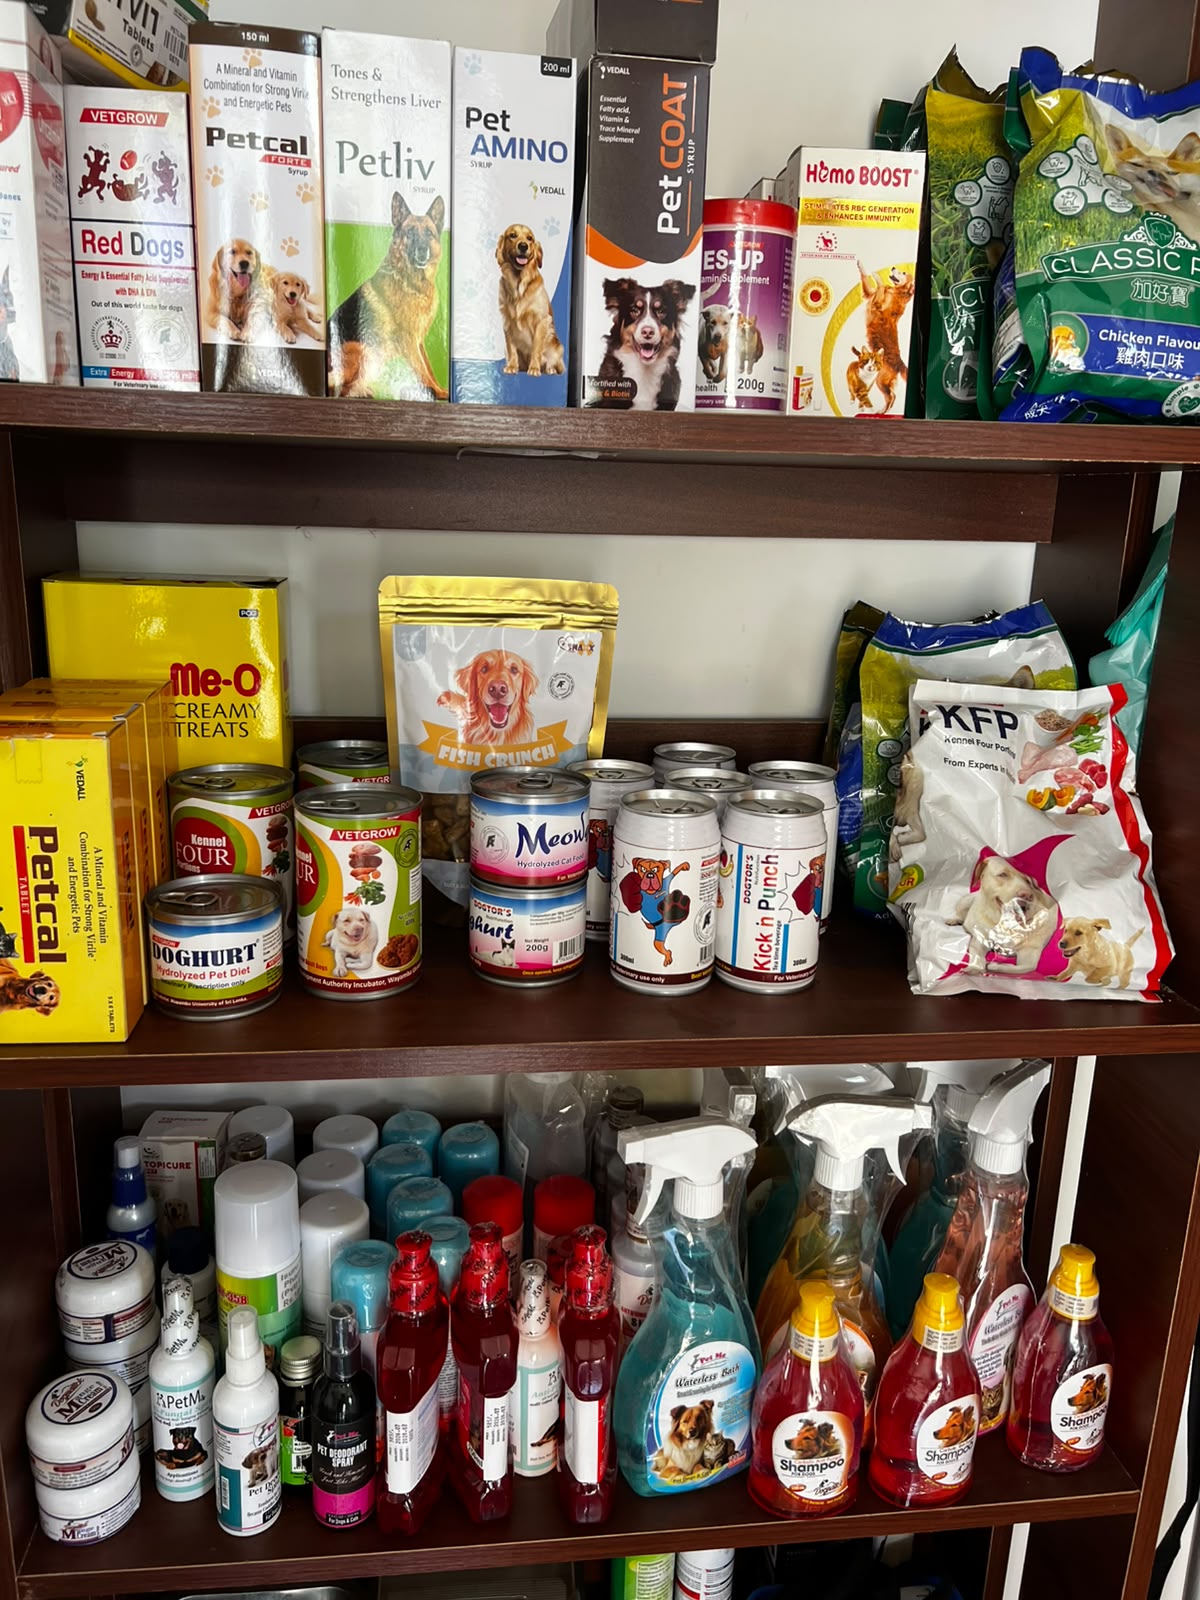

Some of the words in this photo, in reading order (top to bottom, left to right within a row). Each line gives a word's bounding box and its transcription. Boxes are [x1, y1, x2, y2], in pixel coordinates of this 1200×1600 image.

[122, 18, 154, 53] Tablets
[241, 31, 257, 42] 150
[259, 33, 271, 43] ml
[216, 63, 222, 74] A
[224, 64, 251, 77] Mineral
[253, 67, 267, 79] and
[269, 69, 298, 82] Vitamin
[331, 64, 368, 81] Tones
[372, 67, 383, 82] &
[543, 62, 558, 74] 200
[559, 64, 570, 75] ml
[606, 66, 631, 76] VEDALL
[203, 78, 250, 94] Combination
[252, 82, 263, 94] for
[265, 84, 290, 100] Strong
[331, 86, 407, 108] Strengthens
[411, 94, 442, 109] Liver
[224, 96, 237, 108] and
[239, 97, 273, 112] Energetic
[275, 100, 292, 114] Pets
[599, 95, 627, 104] Essential
[91, 110, 157, 126] VETGROW
[599, 105, 616, 114] Fatty
[464, 106, 511, 132] Pet
[599, 115, 623, 124] Vitamin
[624, 116, 630, 124] &
[660, 73, 687, 170] COAT
[599, 125, 616, 133] Trace
[617, 126, 641, 135] Mineral
[206, 126, 308, 156] Petcal
[598, 135, 634, 145] Supplement
[470, 134, 568, 164] AMINO
[687, 139, 695, 174] SYRUP
[271, 155, 308, 166] FORTE
[334, 140, 435, 181] Petliv
[470, 159, 493, 169] SYRUP
[287, 166, 309, 178] Syrup
[859, 165, 913, 188] BOOST
[413, 185, 436, 195] SYRUP
[540, 186, 566, 196] VEDALL
[657, 175, 682, 234] Pet
[851, 204, 867, 213] RBC
[868, 206, 914, 215] GENERATION
[824, 211, 864, 221] ENHANCES
[865, 214, 901, 223] IMMUNITY
[82, 229, 123, 256] Red
[131, 231, 185, 265] Dogs
[1051, 248, 1181, 275] CLASSIC
[1132, 279, 1187, 307] 加好寶
[91, 300, 102, 308] Out
[103, 301, 110, 309] of
[112, 301, 123, 309] this
[1099, 328, 1153, 346] Chicken
[1116, 345, 1185, 371] 雞肉口味
[90, 367, 108, 377] Extra
[111, 369, 135, 381] Energy
[617, 380, 631, 388] with
[737, 377, 765, 394] 200g
[170, 662, 262, 698] Me-O
[174, 702, 261, 719] CREAMY
[174, 721, 249, 739] TREATS
[936, 703, 1019, 741] KFP
[976, 739, 993, 751] Four
[438, 743, 481, 768] FISH
[483, 743, 556, 769] CRUNCH
[943, 757, 966, 769] From
[968, 759, 999, 773] Experts
[76, 769, 86, 800] VEDALL
[191, 833, 227, 848] Kennel
[337, 826, 398, 841] VETGROW
[93, 846, 103, 854] A
[175, 841, 233, 866] FOUR
[67, 856, 77, 873] and
[79, 831, 91, 887] Combination
[517, 859, 560, 871] Hydrolyzed
[561, 857, 571, 867] Cat
[94, 856, 106, 890] Mineral
[757, 854, 779, 912] Punch
[18, 876, 30, 915] TABLET
[28, 825, 68, 964] Petcal
[68, 875, 80, 914] Energetic
[83, 889, 92, 902] for
[97, 891, 107, 908] and
[72, 916, 81, 933] Pets
[84, 903, 94, 931] Strong
[98, 909, 109, 944] Vitamin
[87, 934, 96, 958] Virile
[526, 944, 549, 954] 200g
[753, 932, 773, 972] Kick
[151, 942, 257, 968] DOGHURT
[156, 964, 206, 981] Hydrolyzed
[209, 969, 227, 980] Pet
[230, 967, 251, 979] Diet
[639, 974, 650, 982] use
[651, 975, 665, 985] only
[774, 975, 785, 984] For
[188, 982, 230, 992] Prescription
[231, 979, 246, 989] only
[322, 978, 352, 991] Authority
[353, 979, 387, 990] Incubator,
[144, 1160, 191, 1171] TOPICURE
[700, 1354, 713, 1367] Pet
[714, 1351, 727, 1361] Me
[675, 1371, 718, 1390] Waterless
[721, 1361, 740, 1379] Bath
[317, 1442, 328, 1457] PET
[329, 1439, 368, 1459] DEODORANT
[332, 1456, 355, 1469] SPRAY
[780, 1457, 845, 1475] Shampoo
[249, 1487, 263, 1498] Pet
